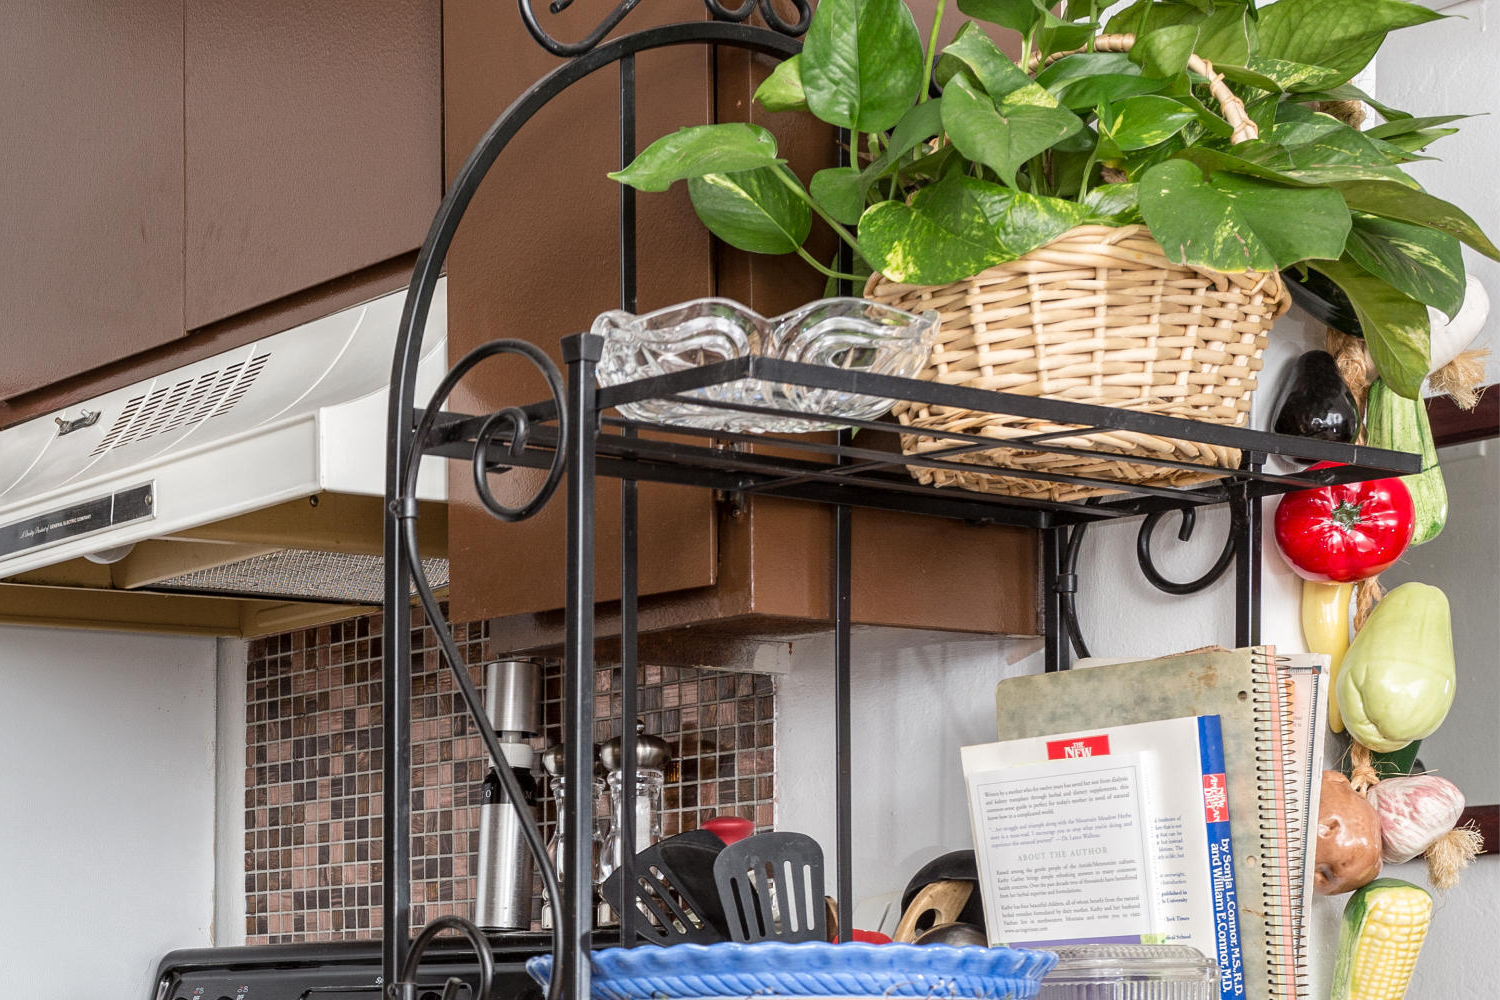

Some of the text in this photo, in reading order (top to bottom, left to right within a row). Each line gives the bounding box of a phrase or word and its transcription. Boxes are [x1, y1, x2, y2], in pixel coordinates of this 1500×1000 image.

[1018, 846, 1109, 862] ABOUT THE AUTHOR
[1211, 843, 1222, 866] and
[1220, 838, 1230, 853] by
[1223, 854, 1234, 889] Sonja
[1213, 867, 1225, 911] William
